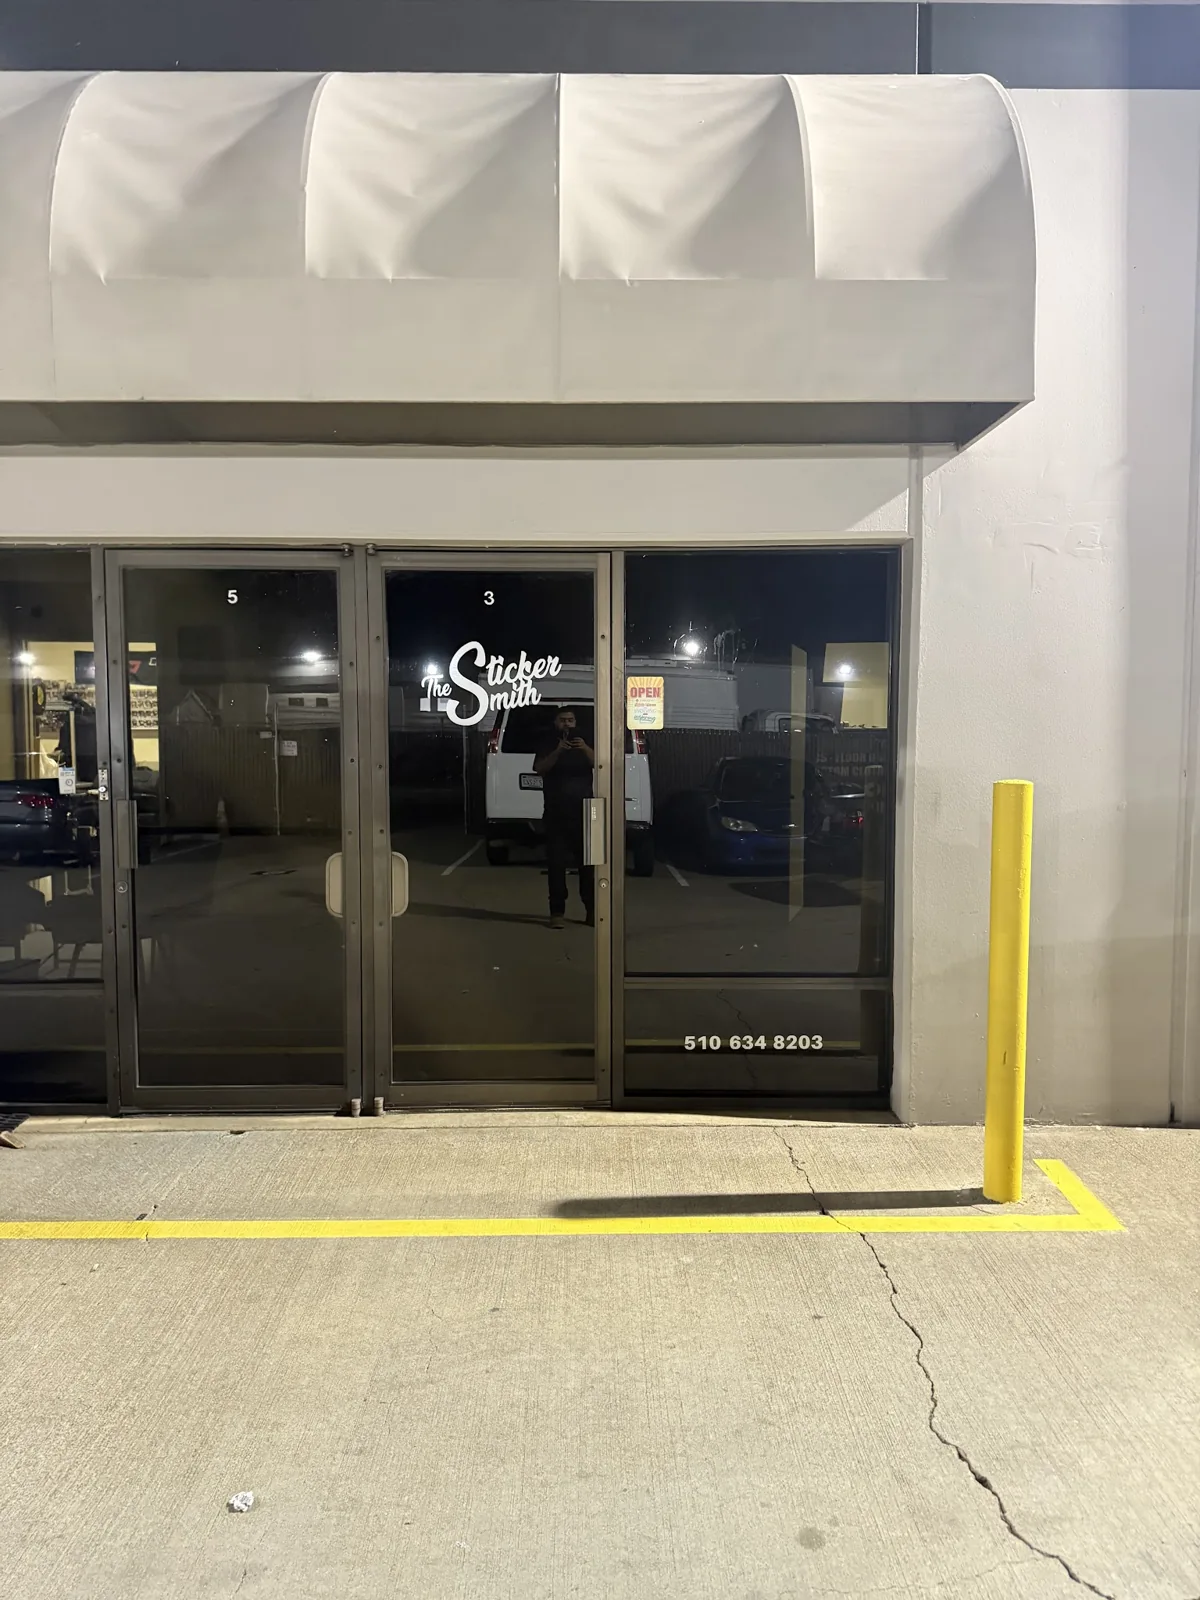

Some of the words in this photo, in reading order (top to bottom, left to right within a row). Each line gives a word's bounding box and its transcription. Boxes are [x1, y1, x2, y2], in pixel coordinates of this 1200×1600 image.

[227, 589, 239, 605] 5
[483, 590, 496, 606] 3
[420, 674, 453, 700] The
[446, 640, 562, 726] Sticker
[630, 687, 661, 698] OPEN
[684, 1035, 721, 1050] 510
[729, 1035, 767, 1050] 634
[773, 1034, 824, 1050] 8203
